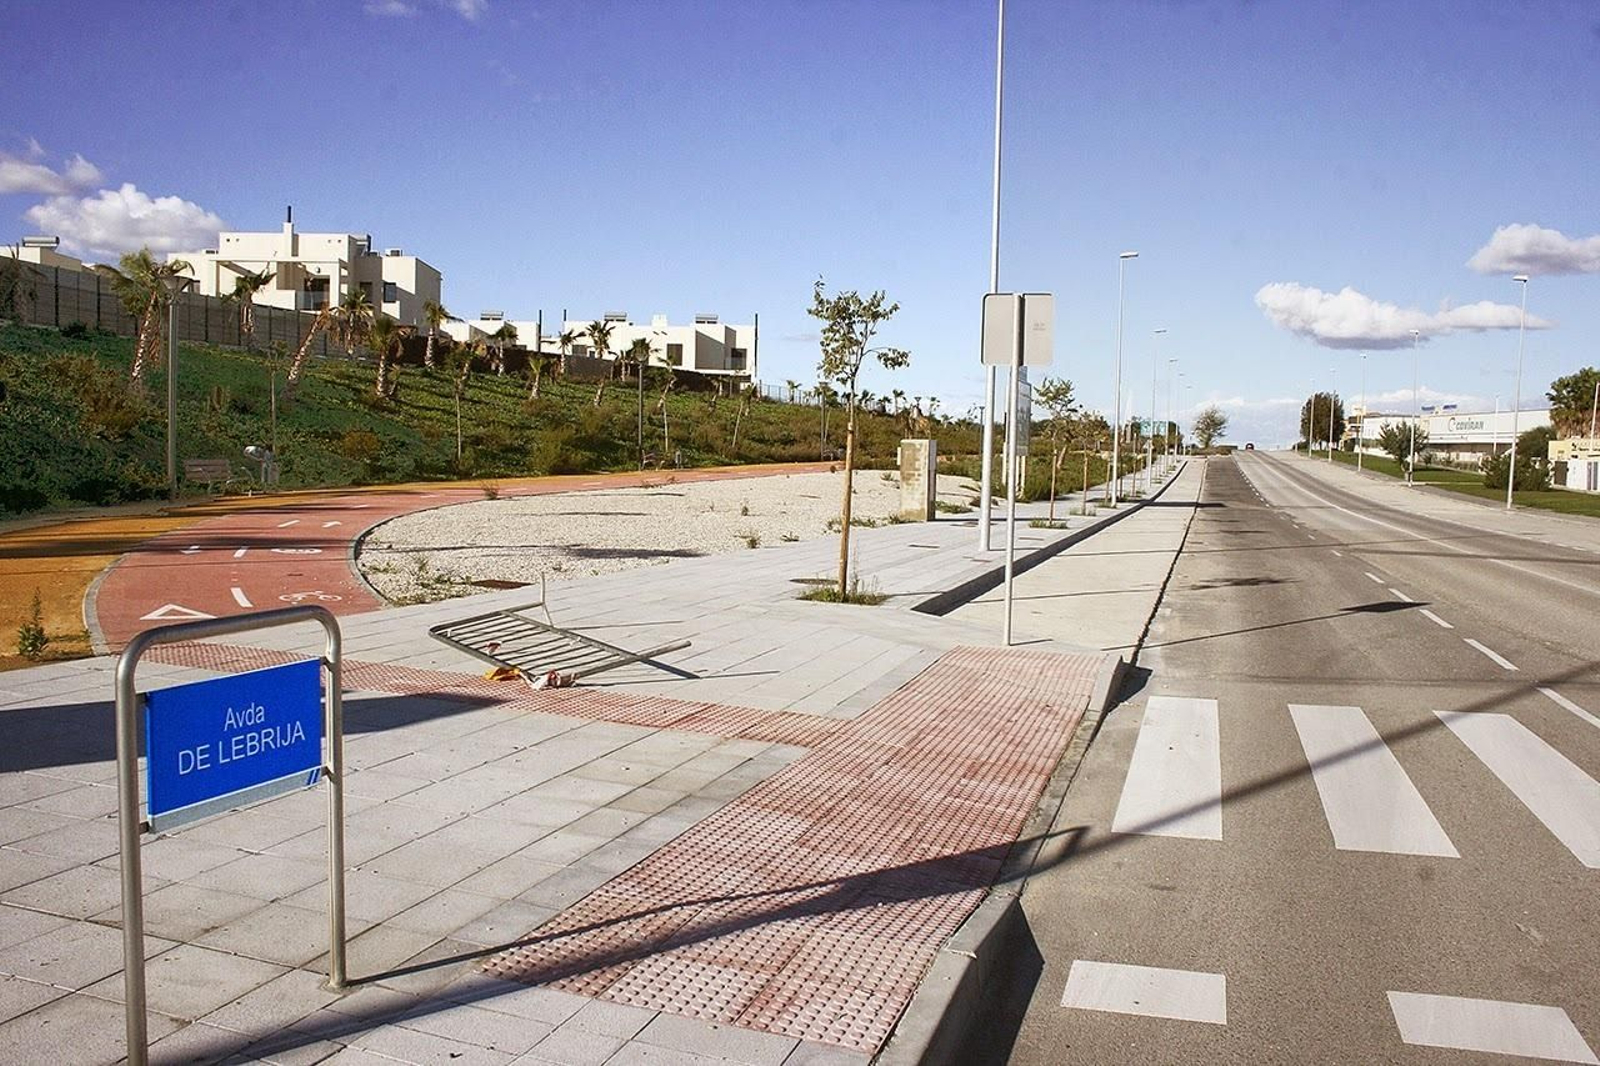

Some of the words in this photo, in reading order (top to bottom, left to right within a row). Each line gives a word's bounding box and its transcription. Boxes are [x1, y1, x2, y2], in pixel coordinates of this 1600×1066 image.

[224, 702, 265, 731] Avda
[179, 744, 211, 775] DE
[218, 720, 306, 764] LEBRIJA
